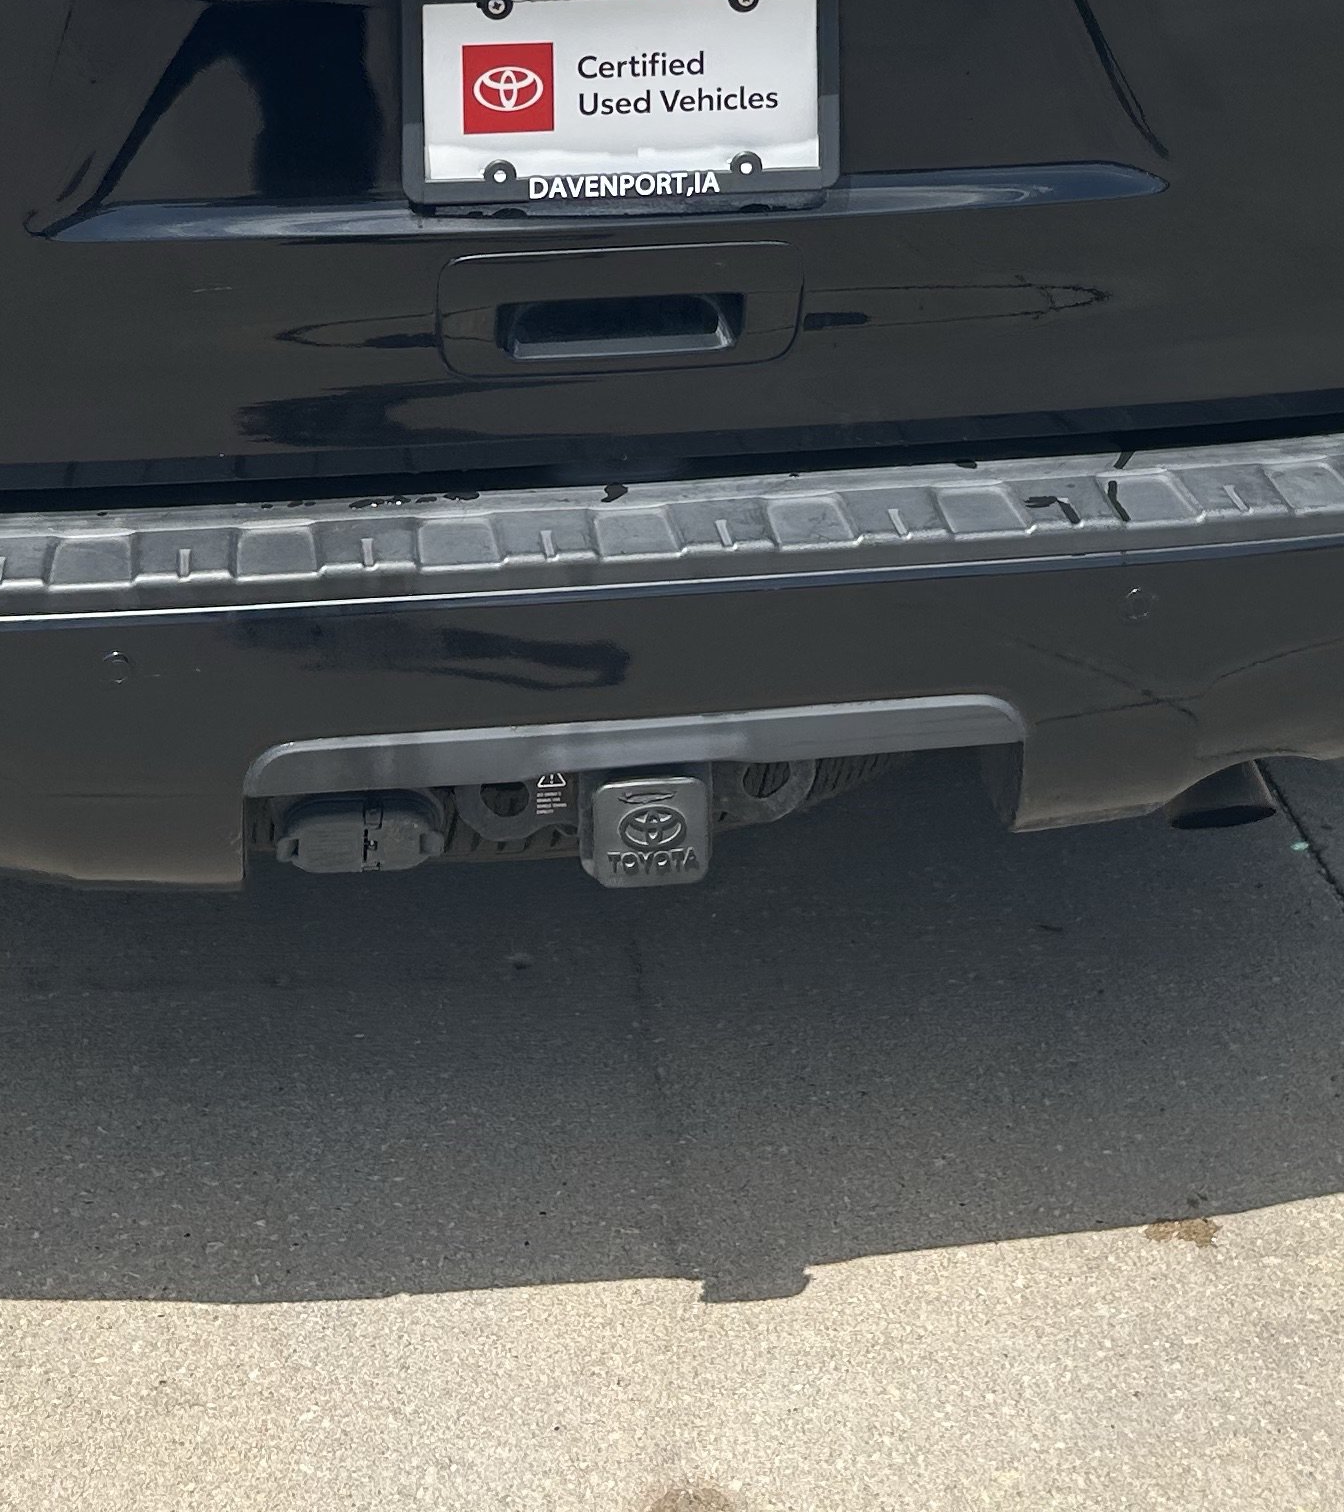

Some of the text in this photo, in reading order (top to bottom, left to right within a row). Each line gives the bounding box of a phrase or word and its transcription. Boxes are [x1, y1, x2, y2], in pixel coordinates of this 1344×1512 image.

[577, 51, 705, 79] Certified
[578, 85, 778, 116] Used Vehicles
[606, 847, 699, 877] TOYOTA
